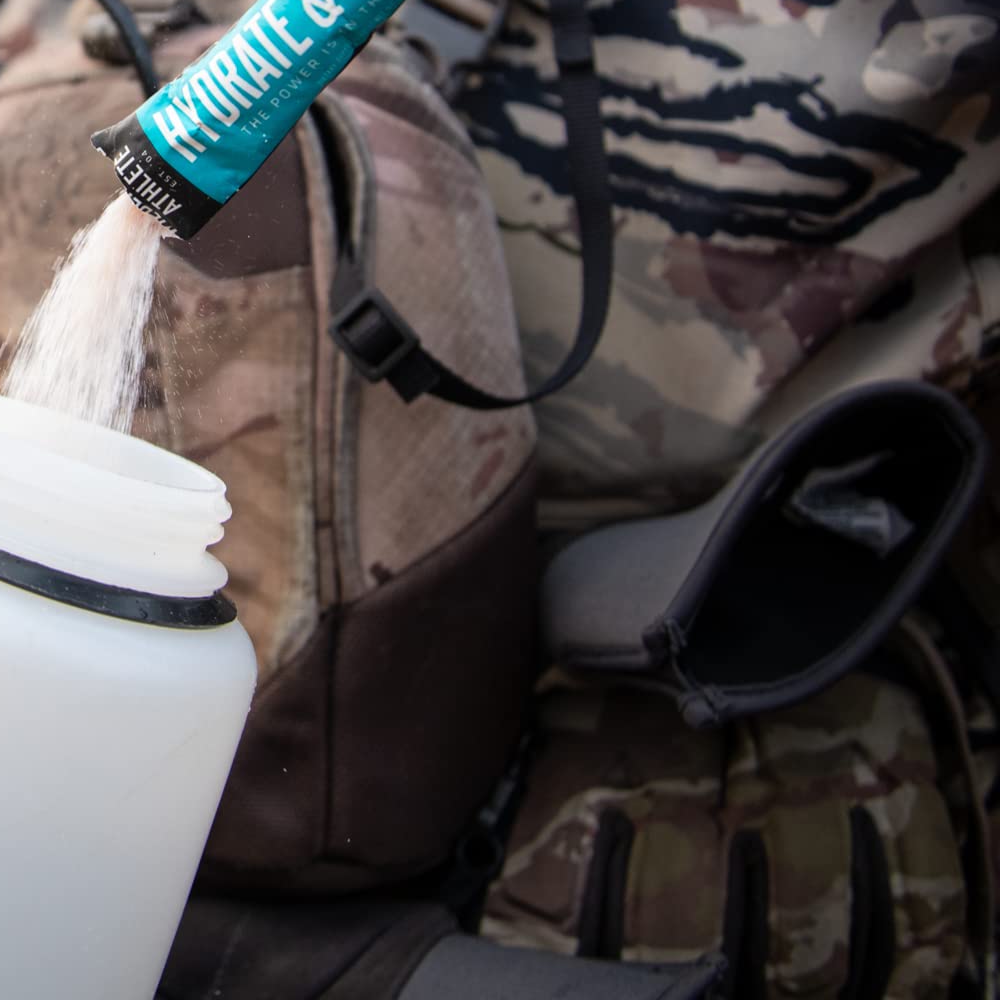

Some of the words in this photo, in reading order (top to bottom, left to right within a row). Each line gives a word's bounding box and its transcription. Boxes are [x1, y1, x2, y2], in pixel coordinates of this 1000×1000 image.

[241, 110, 271, 136] THE
[270, 59, 321, 108] POWER
[321, 40, 337, 55] IS
[114, 145, 183, 216] ATHLETE
